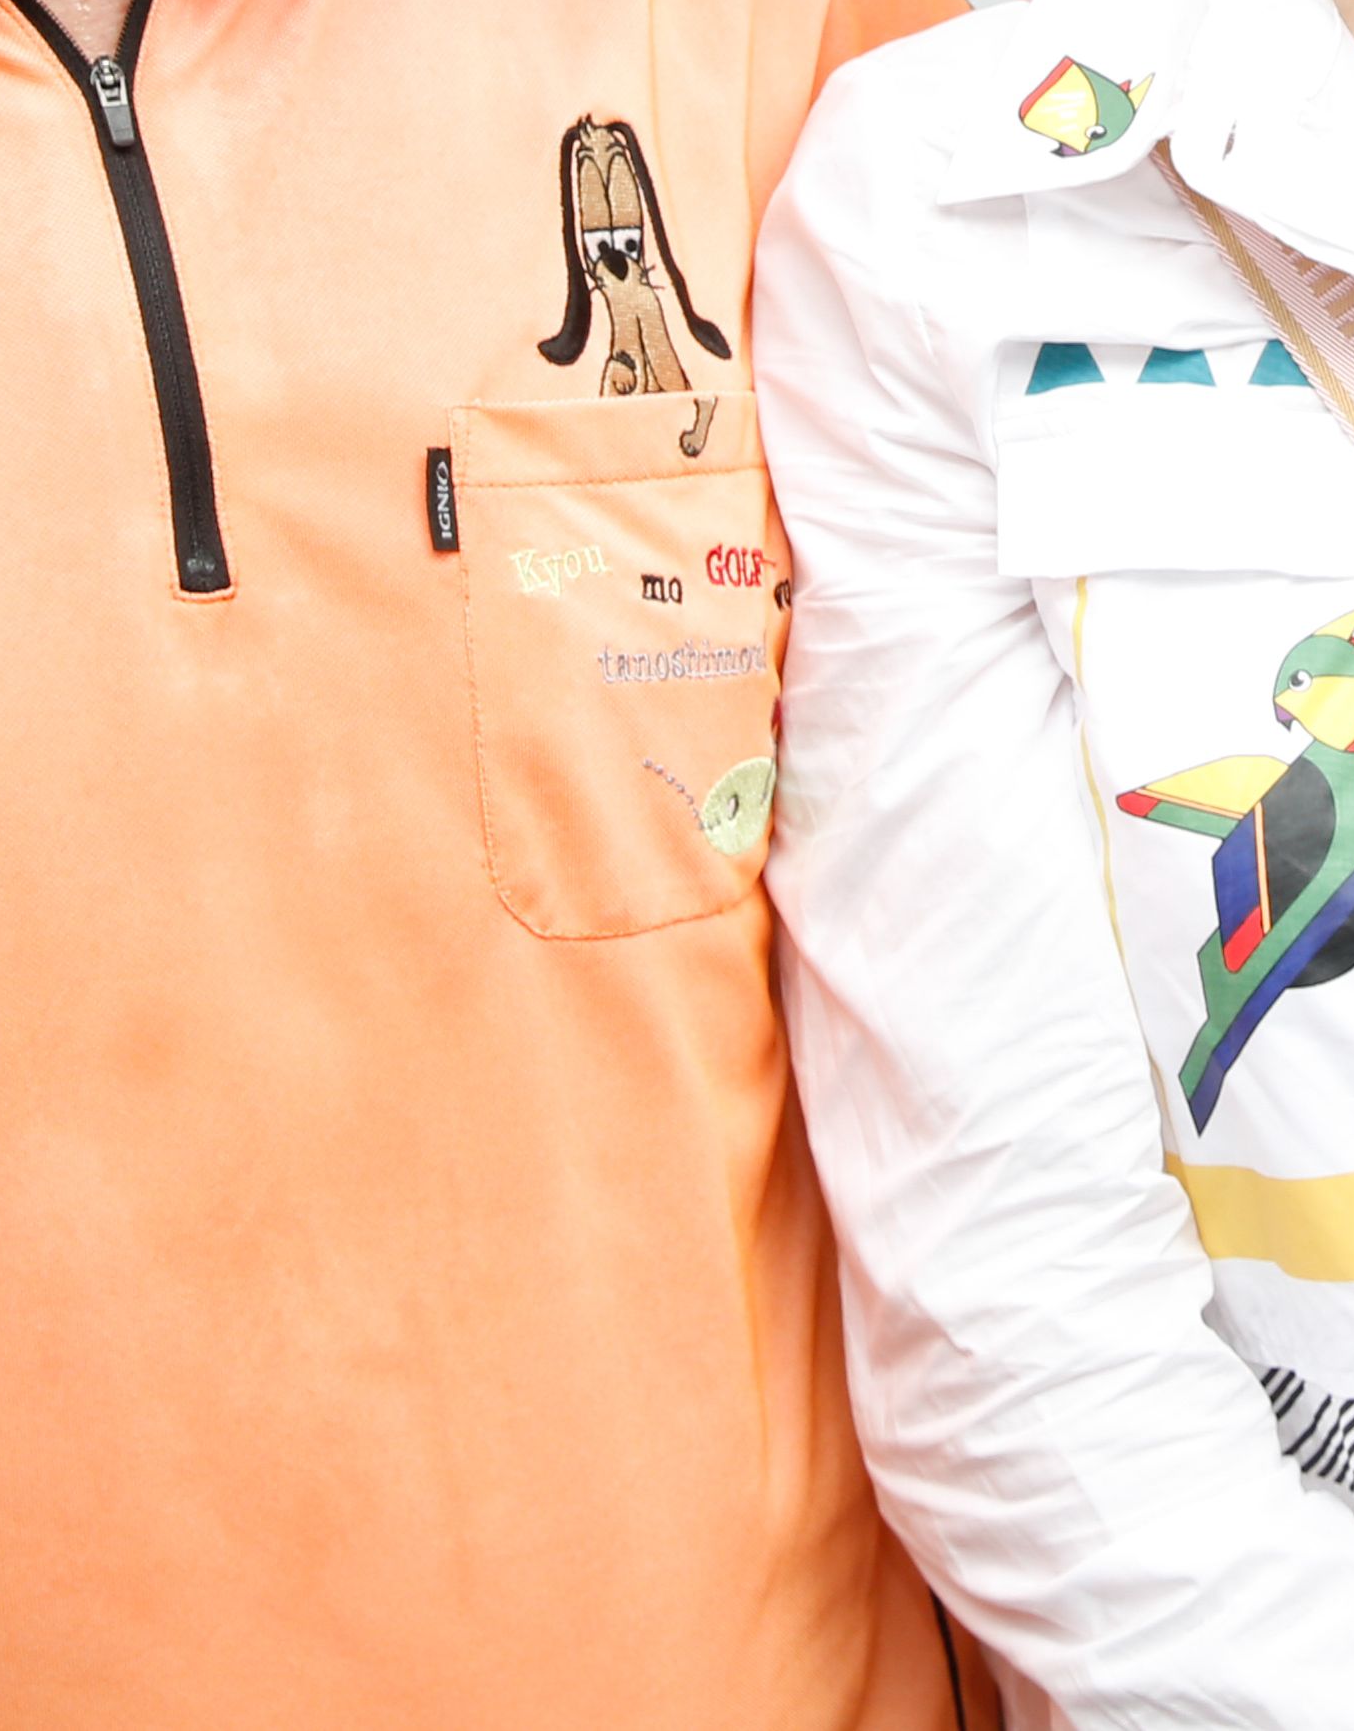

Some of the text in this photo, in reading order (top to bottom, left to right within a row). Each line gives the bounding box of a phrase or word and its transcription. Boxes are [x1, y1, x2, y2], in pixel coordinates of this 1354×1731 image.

[436, 460, 453, 540] IGNIO
[510, 543, 777, 604] Kyou mo GOLF
